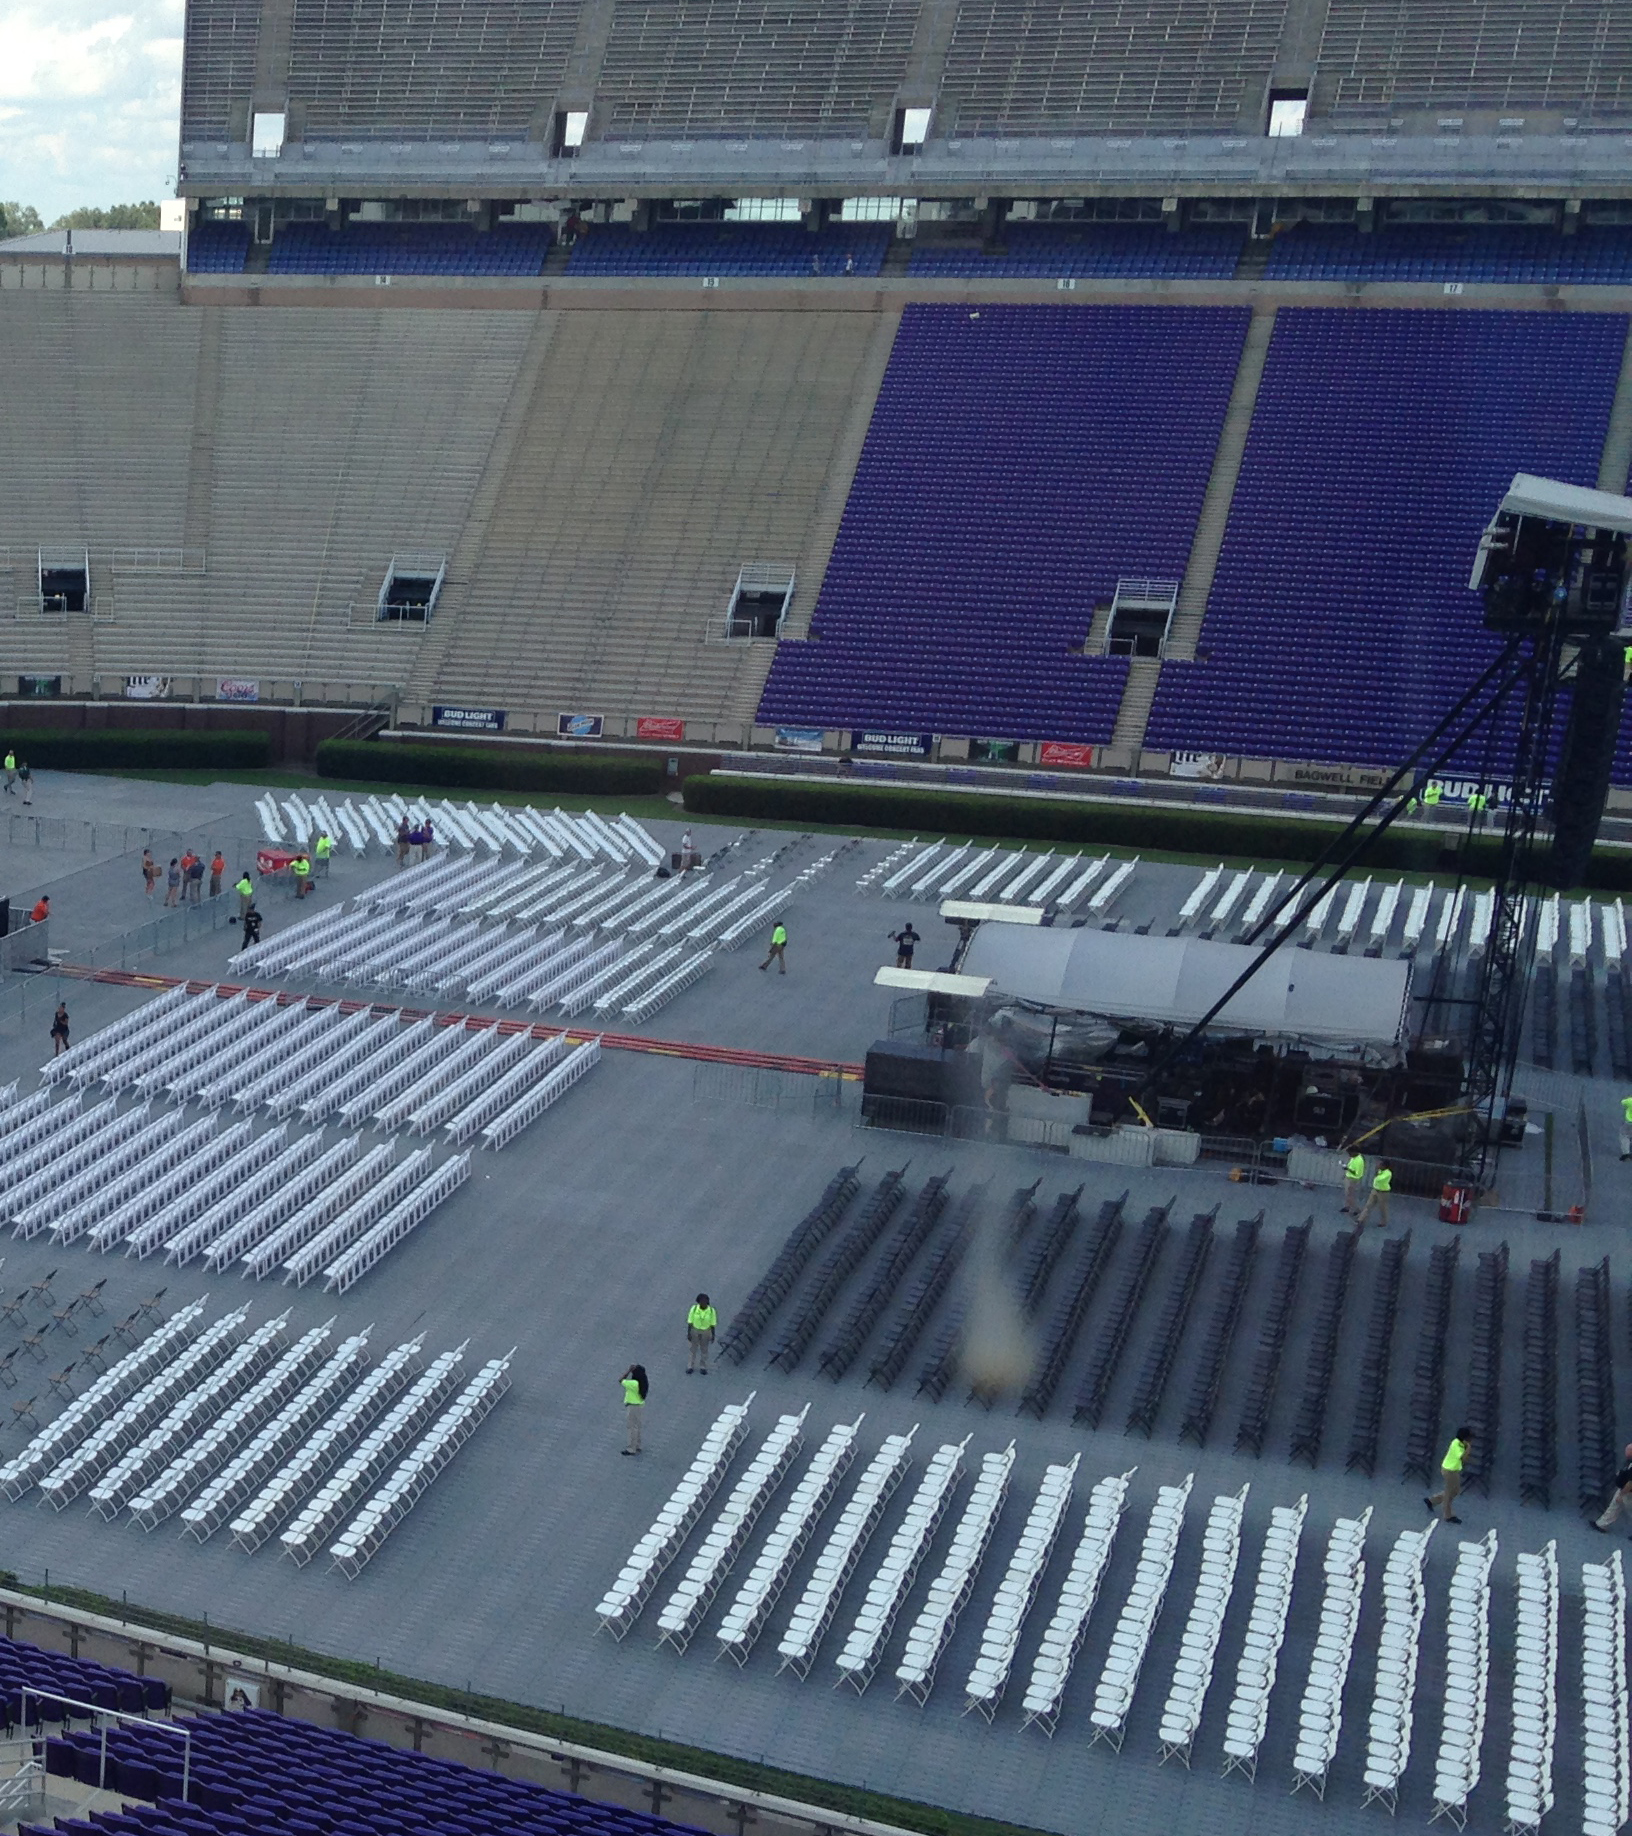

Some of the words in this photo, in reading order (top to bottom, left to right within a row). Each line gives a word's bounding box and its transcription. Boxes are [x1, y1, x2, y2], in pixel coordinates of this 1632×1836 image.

[443, 709, 464, 718] BUD
[465, 712, 493, 721] LIGHT
[864, 733, 886, 743] BUD
[887, 735, 919, 746] LIGHT
[1294, 769, 1354, 784] BAGWELL
